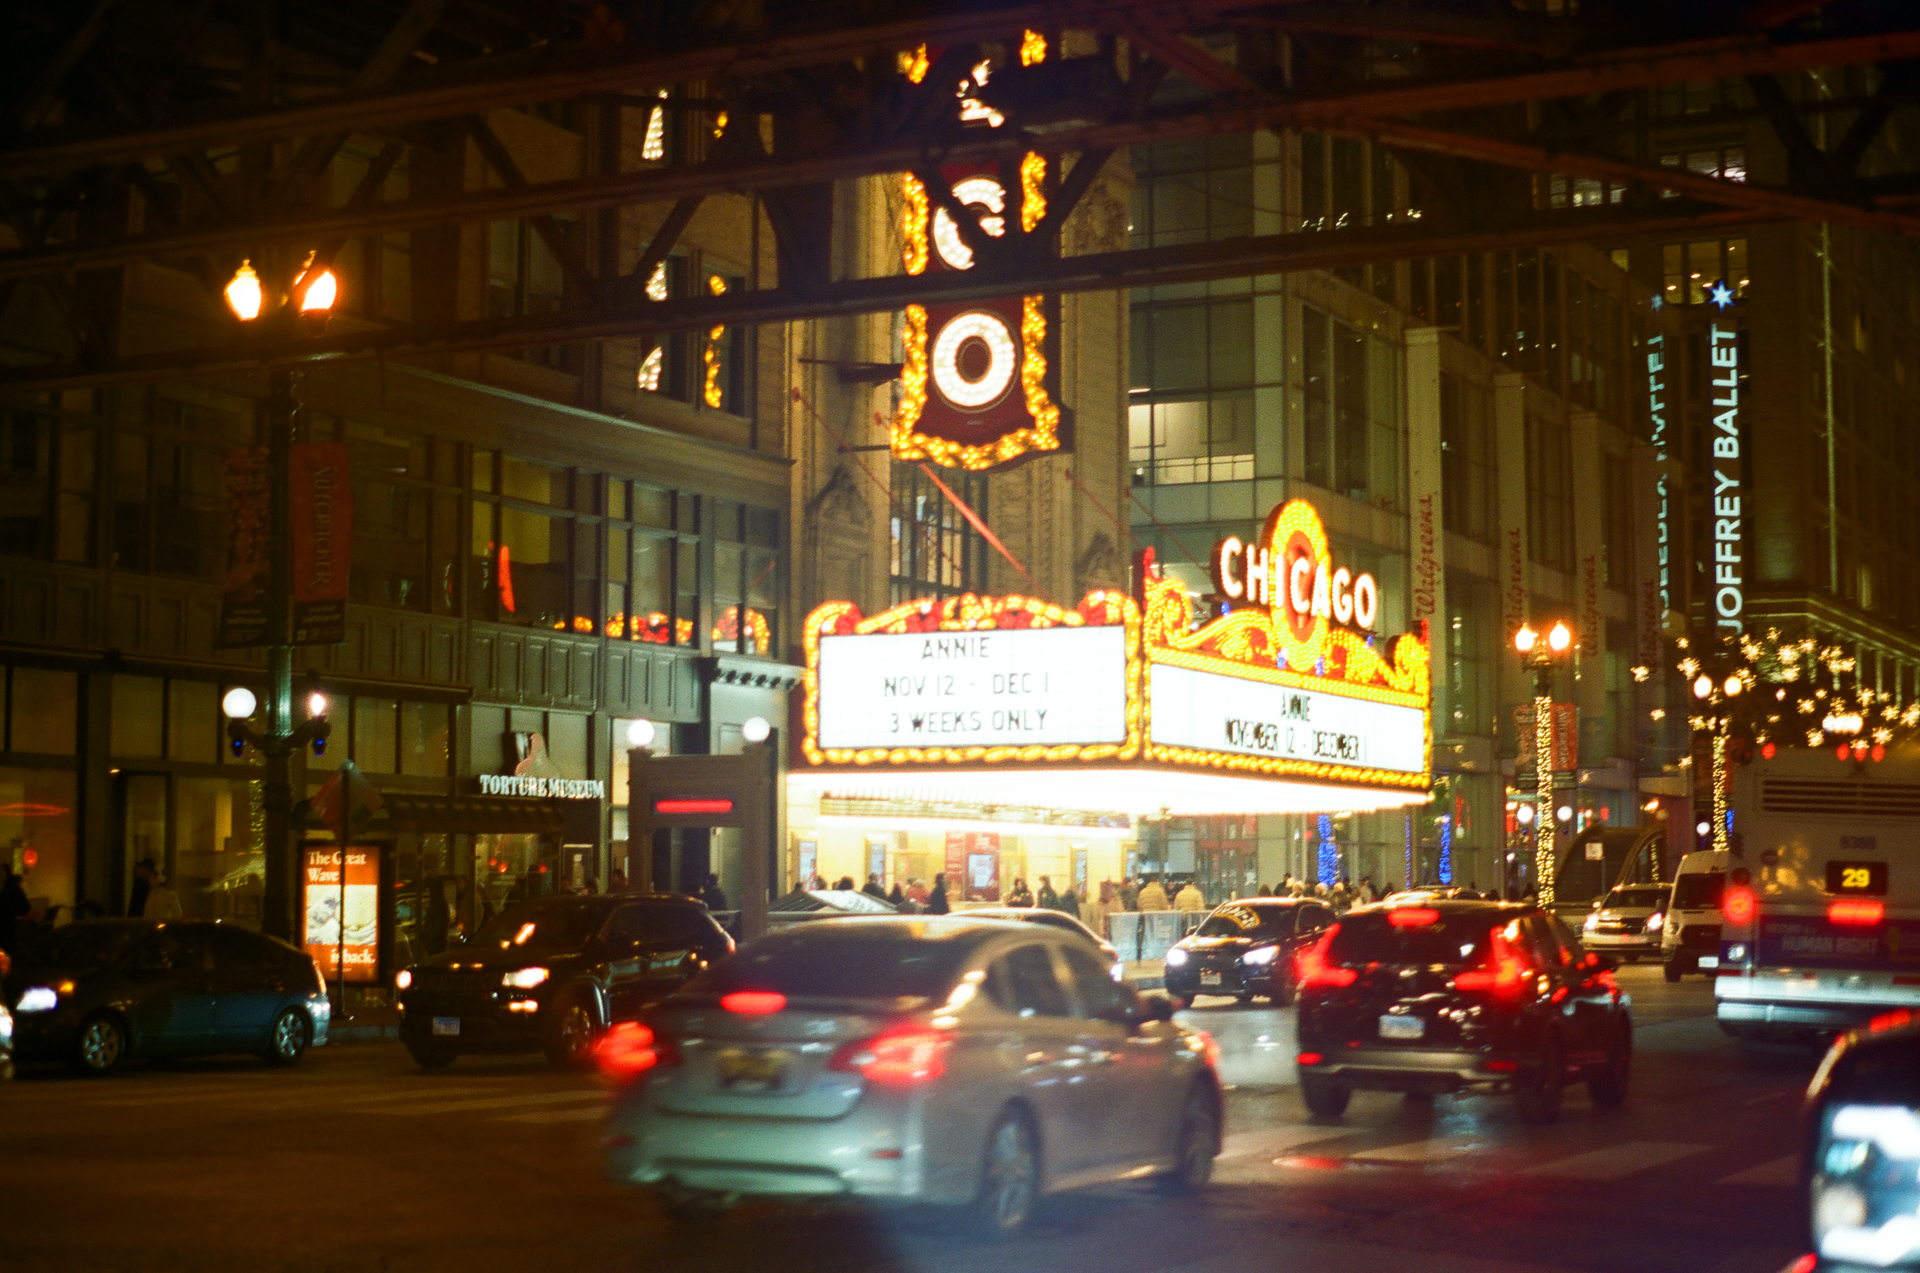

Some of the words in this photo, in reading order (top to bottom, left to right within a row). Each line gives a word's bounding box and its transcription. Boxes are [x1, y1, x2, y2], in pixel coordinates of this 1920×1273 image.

[1711, 323, 1739, 459] BALLET
[1414, 494, 1441, 616] Walgreens
[1714, 469, 1743, 635] JOFFREY
[1219, 536, 1378, 629] CHICAGO
[921, 637, 990, 659] ANNIE
[884, 675, 926, 697] NOV
[936, 675, 955, 696] 12
[993, 672, 1031, 695] DEC
[1281, 692, 1310, 722] ANNIE
[891, 713, 899, 733] 3
[909, 711, 982, 733] WEEKS
[992, 708, 1048, 731] ONLY
[1224, 716, 1279, 756] NOVEMBER
[1311, 728, 1359, 761] DECEMBER
[479, 774, 547, 797] TORTURE
[548, 778, 605, 799] MUSEUM
[307, 851, 331, 865] The
[307, 867, 340, 882] Wave
[1842, 868, 1870, 888] 29
